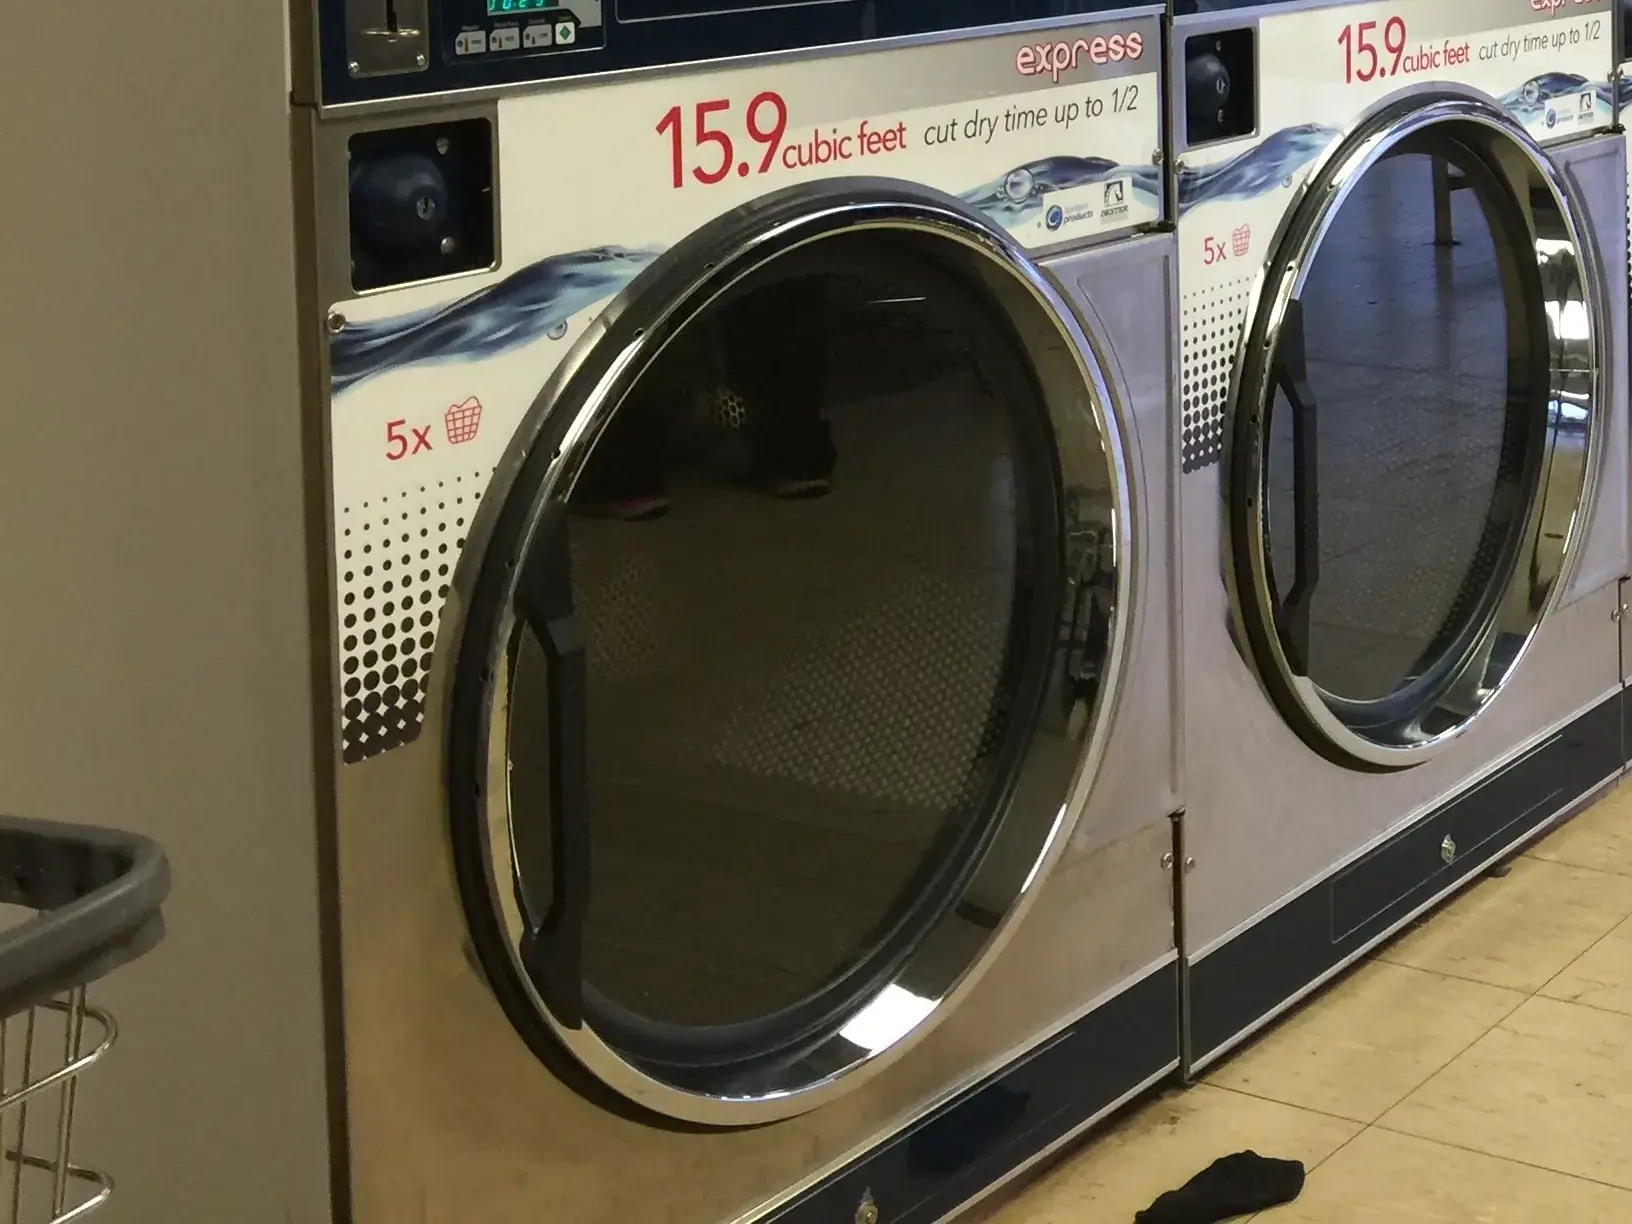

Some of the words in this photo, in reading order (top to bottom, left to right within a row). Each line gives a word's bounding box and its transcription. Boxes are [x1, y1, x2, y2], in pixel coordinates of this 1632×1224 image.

[1015, 30, 1144, 83] express
[1337, 16, 1406, 85] 15.9
[1403, 45, 1441, 75] cubic
[1443, 39, 1470, 66] feet
[1479, 40, 1498, 60] cut
[1501, 34, 1521, 62] dry
[1523, 32, 1549, 53] time
[1551, 31, 1567, 53] up
[1569, 27, 1580, 44] to
[1585, 19, 1601, 41] 1/2
[655, 90, 788, 189] 15.9
[781, 128, 853, 170] cubic
[857, 120, 907, 156] feet
[924, 117, 958, 146] cut
[964, 108, 999, 144] dry
[1004, 104, 1048, 132] time
[1054, 101, 1080, 130] up
[1085, 95, 1104, 118] to
[1112, 84, 1139, 114] 1/2
[1203, 236, 1228, 265] 5x
[386, 419, 433, 460] 5x
